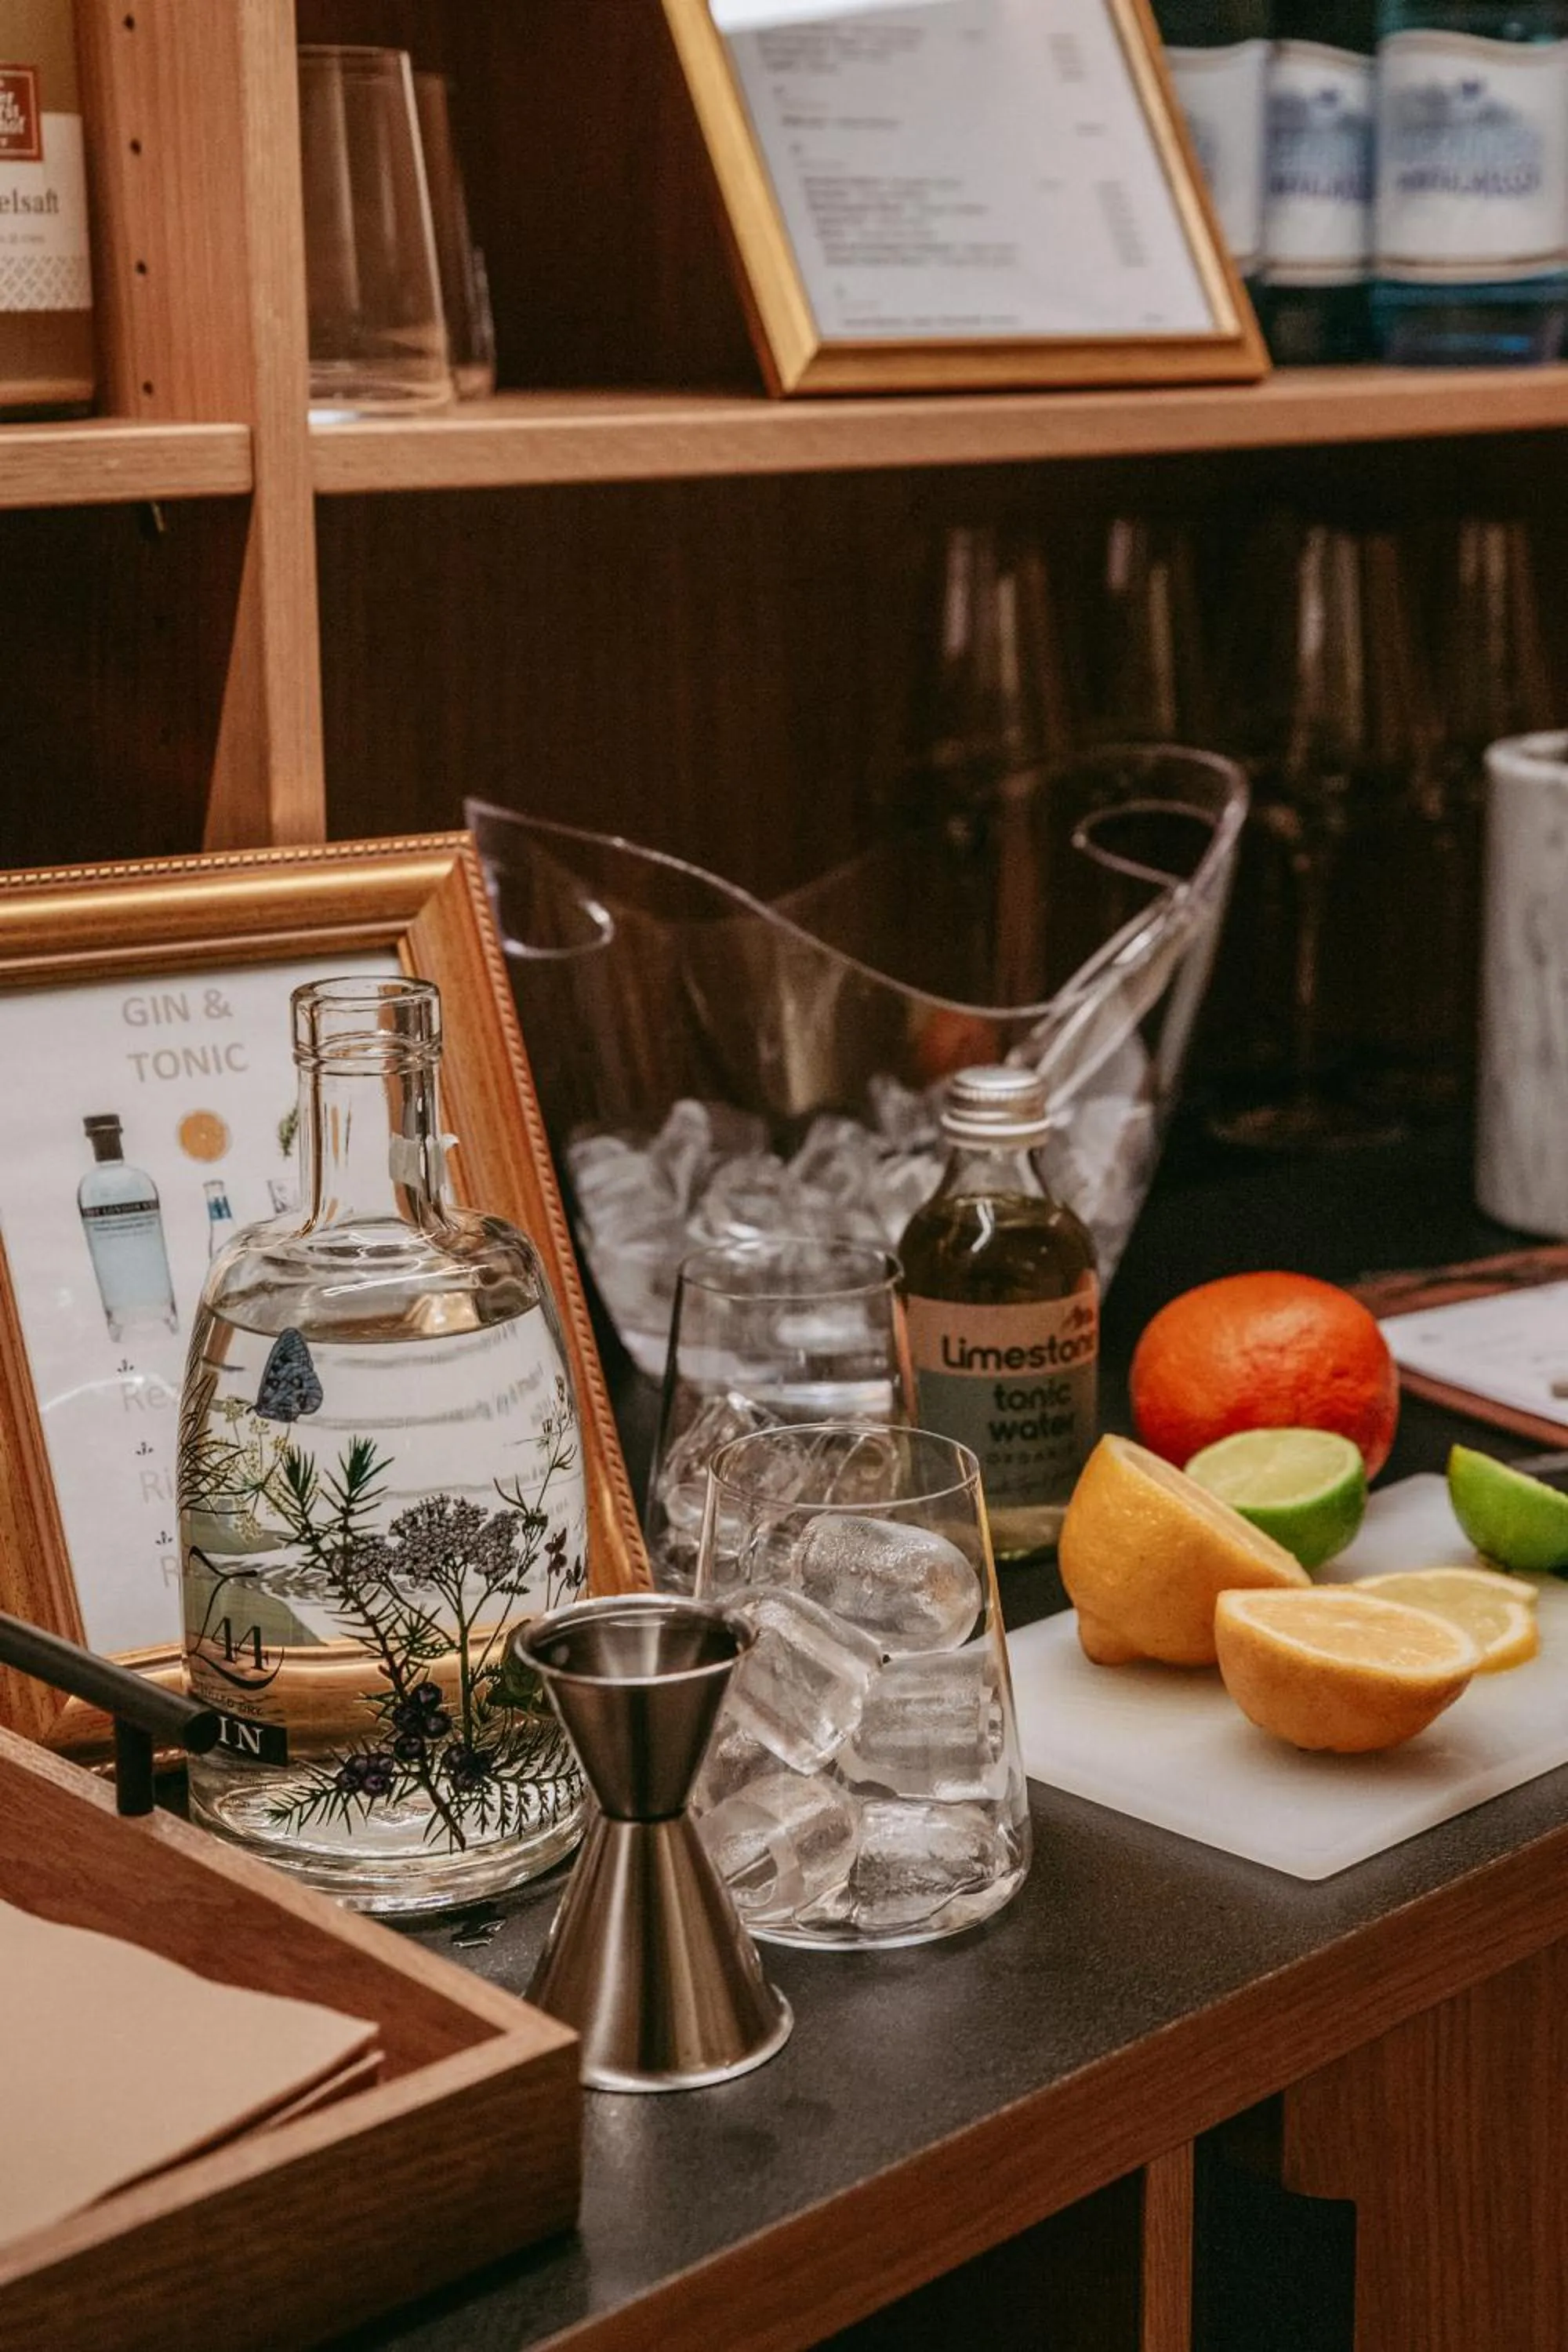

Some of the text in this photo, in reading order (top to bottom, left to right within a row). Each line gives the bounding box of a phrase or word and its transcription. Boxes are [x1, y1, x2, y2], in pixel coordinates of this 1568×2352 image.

[122, 988, 234, 1027] GIN &
[125, 1041, 250, 1083] TONIC
[942, 1329, 1095, 1370] Limeston
[994, 1377, 1073, 1412] tonic
[988, 1411, 1075, 1443] water
[217, 1715, 264, 1755] IN
